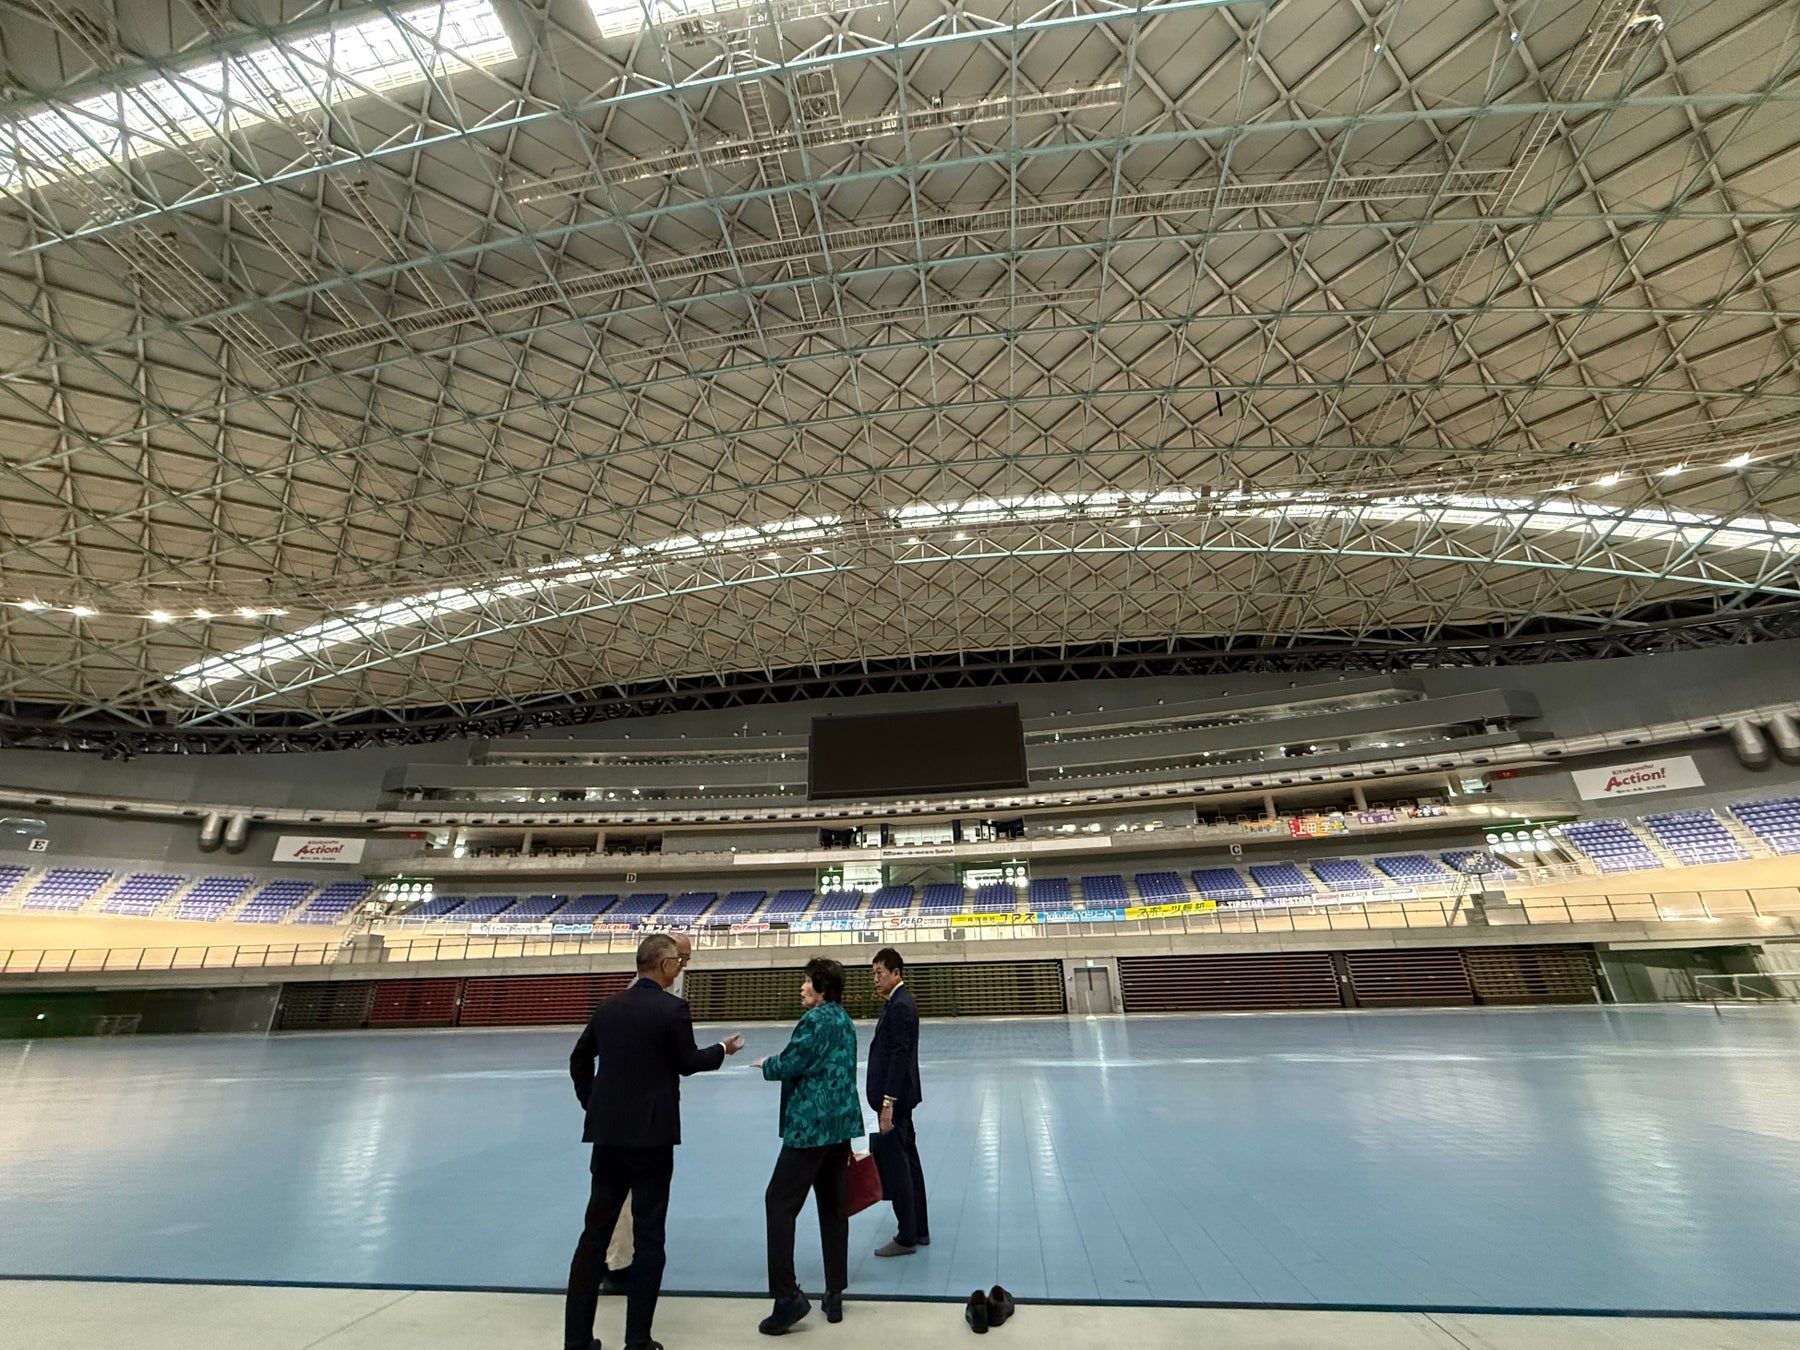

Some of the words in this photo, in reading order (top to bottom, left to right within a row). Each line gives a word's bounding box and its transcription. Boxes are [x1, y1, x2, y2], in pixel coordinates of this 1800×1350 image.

[1604, 768, 1665, 792] Action!
[33, 841, 45, 849] E
[1232, 845, 1240, 854] C
[293, 845, 344, 857] Action!
[628, 874, 635, 882] D
